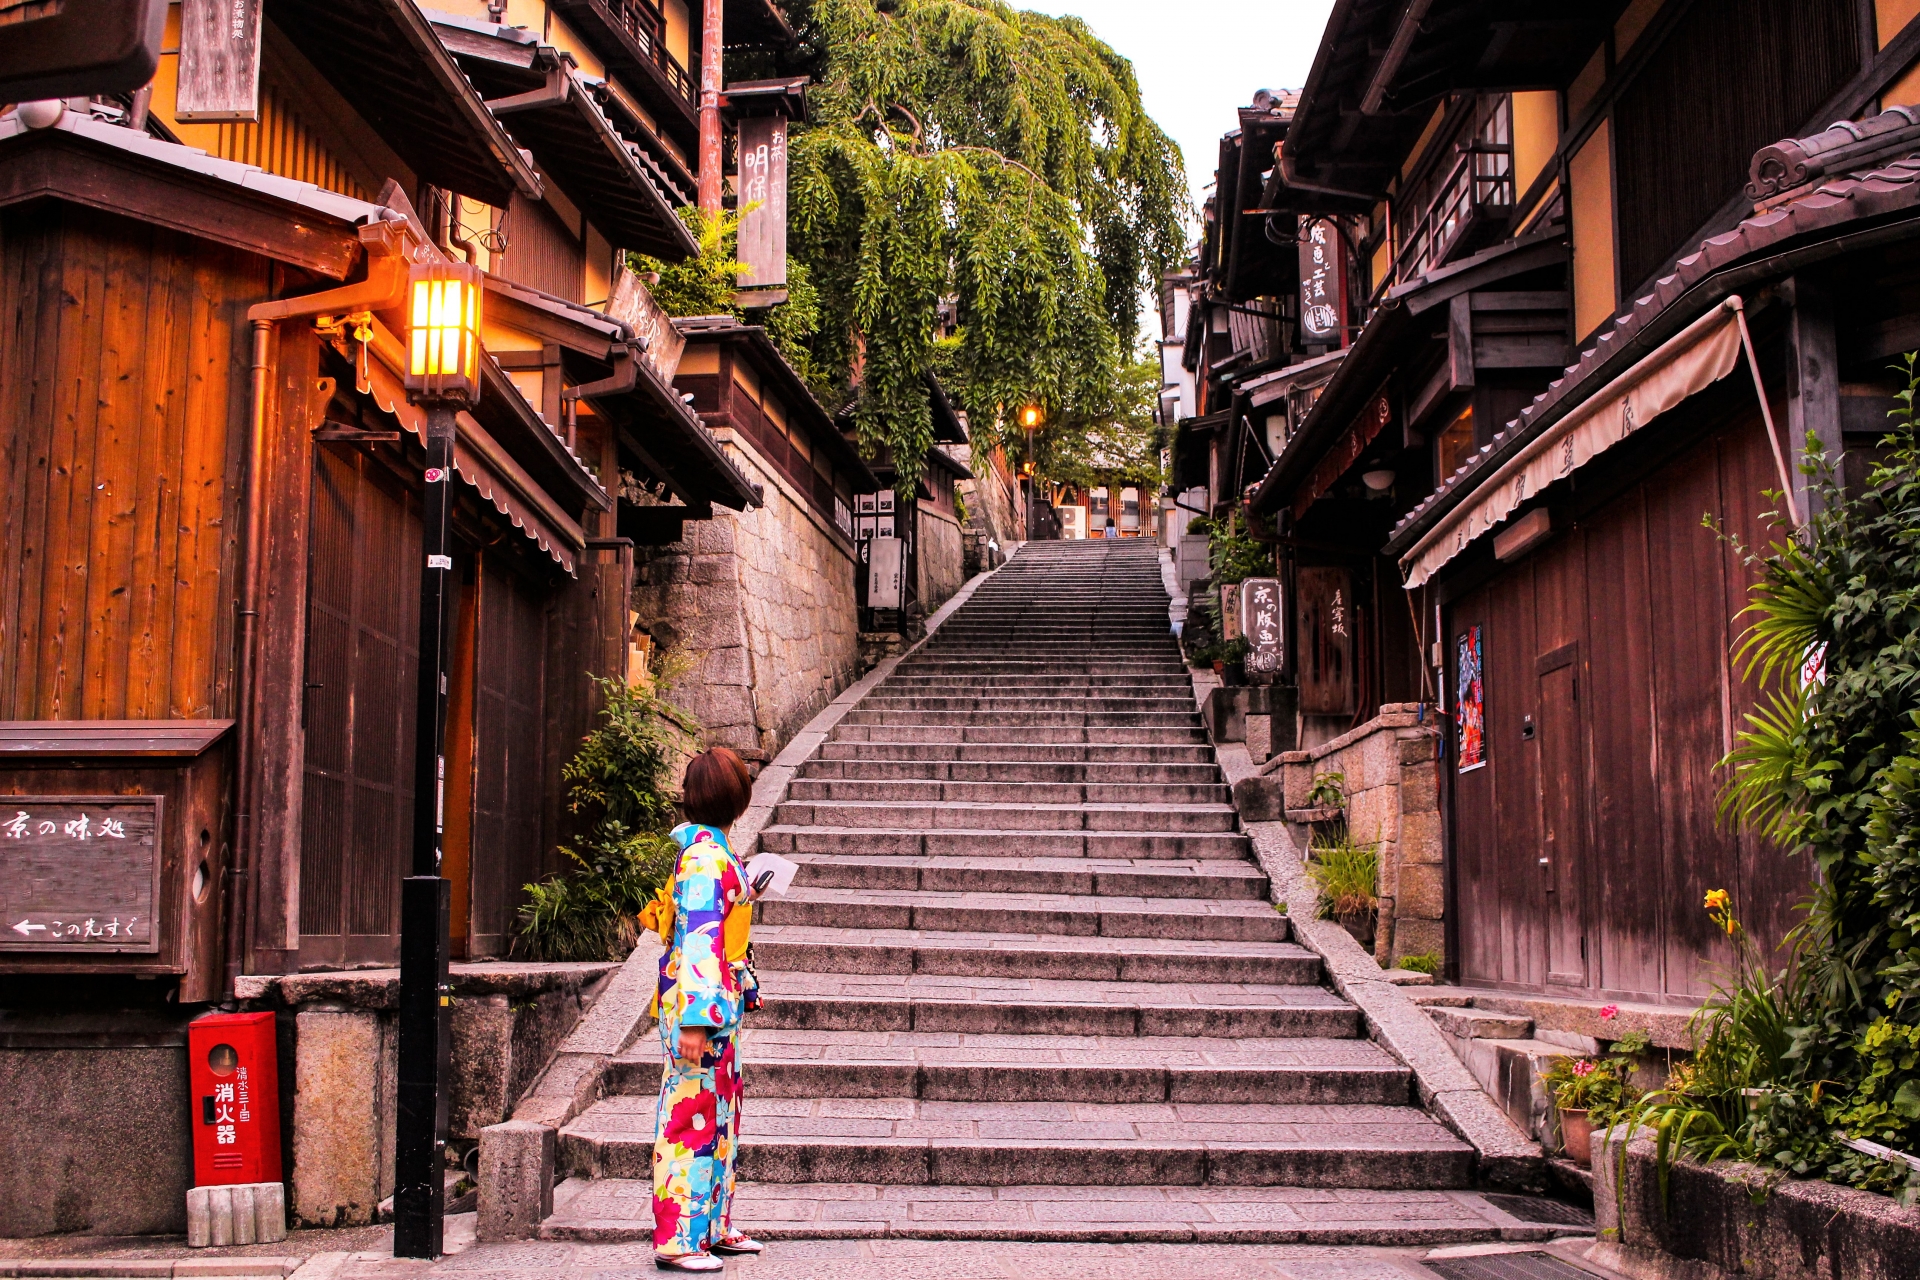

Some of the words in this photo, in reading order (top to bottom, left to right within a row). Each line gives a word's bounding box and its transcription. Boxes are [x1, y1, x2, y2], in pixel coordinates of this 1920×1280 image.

[1254, 586, 1277, 644] 京の版画
[2, 811, 126, 840] 京の味処
[52, 917, 138, 937] この先すぐ
[215, 1083, 236, 1144] 消火器
[236, 1066, 250, 1122] 清水三丁目
